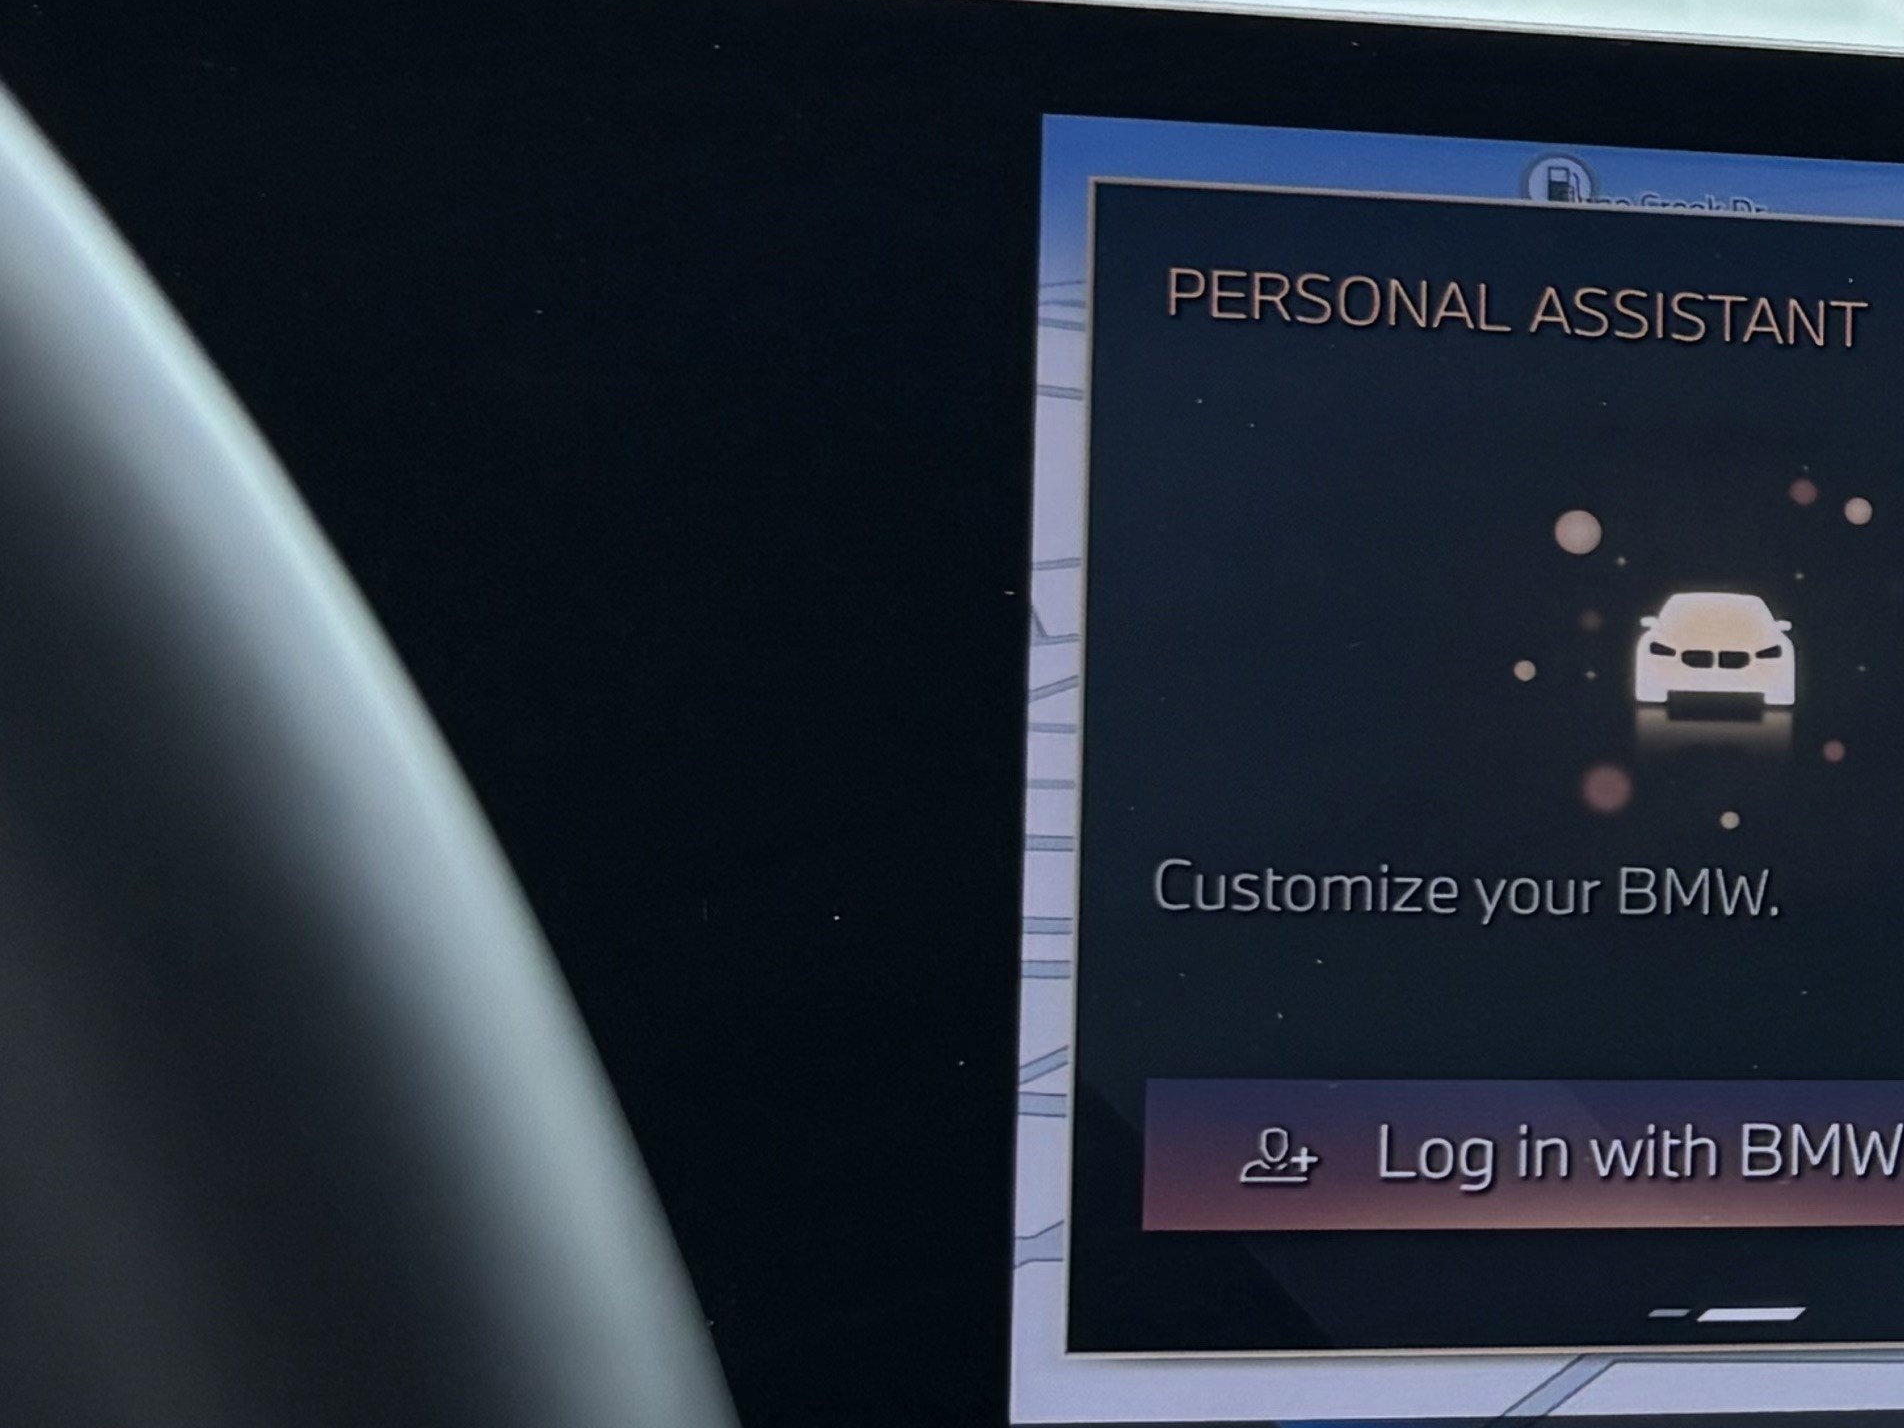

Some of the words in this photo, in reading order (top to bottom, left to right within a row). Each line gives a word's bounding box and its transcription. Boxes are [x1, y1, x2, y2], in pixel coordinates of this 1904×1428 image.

[1166, 267, 1512, 333] PERSONAL
[1529, 286, 1869, 347] ASSISTANT
[1154, 859, 1458, 914] Customize
[1473, 875, 1602, 925] your
[1618, 866, 1780, 917] BMW.
[1377, 1123, 1495, 1192] Log
[1518, 1123, 1569, 1178] in
[1590, 1123, 1718, 1178] with
[1741, 1122, 1904, 1177] BMW
